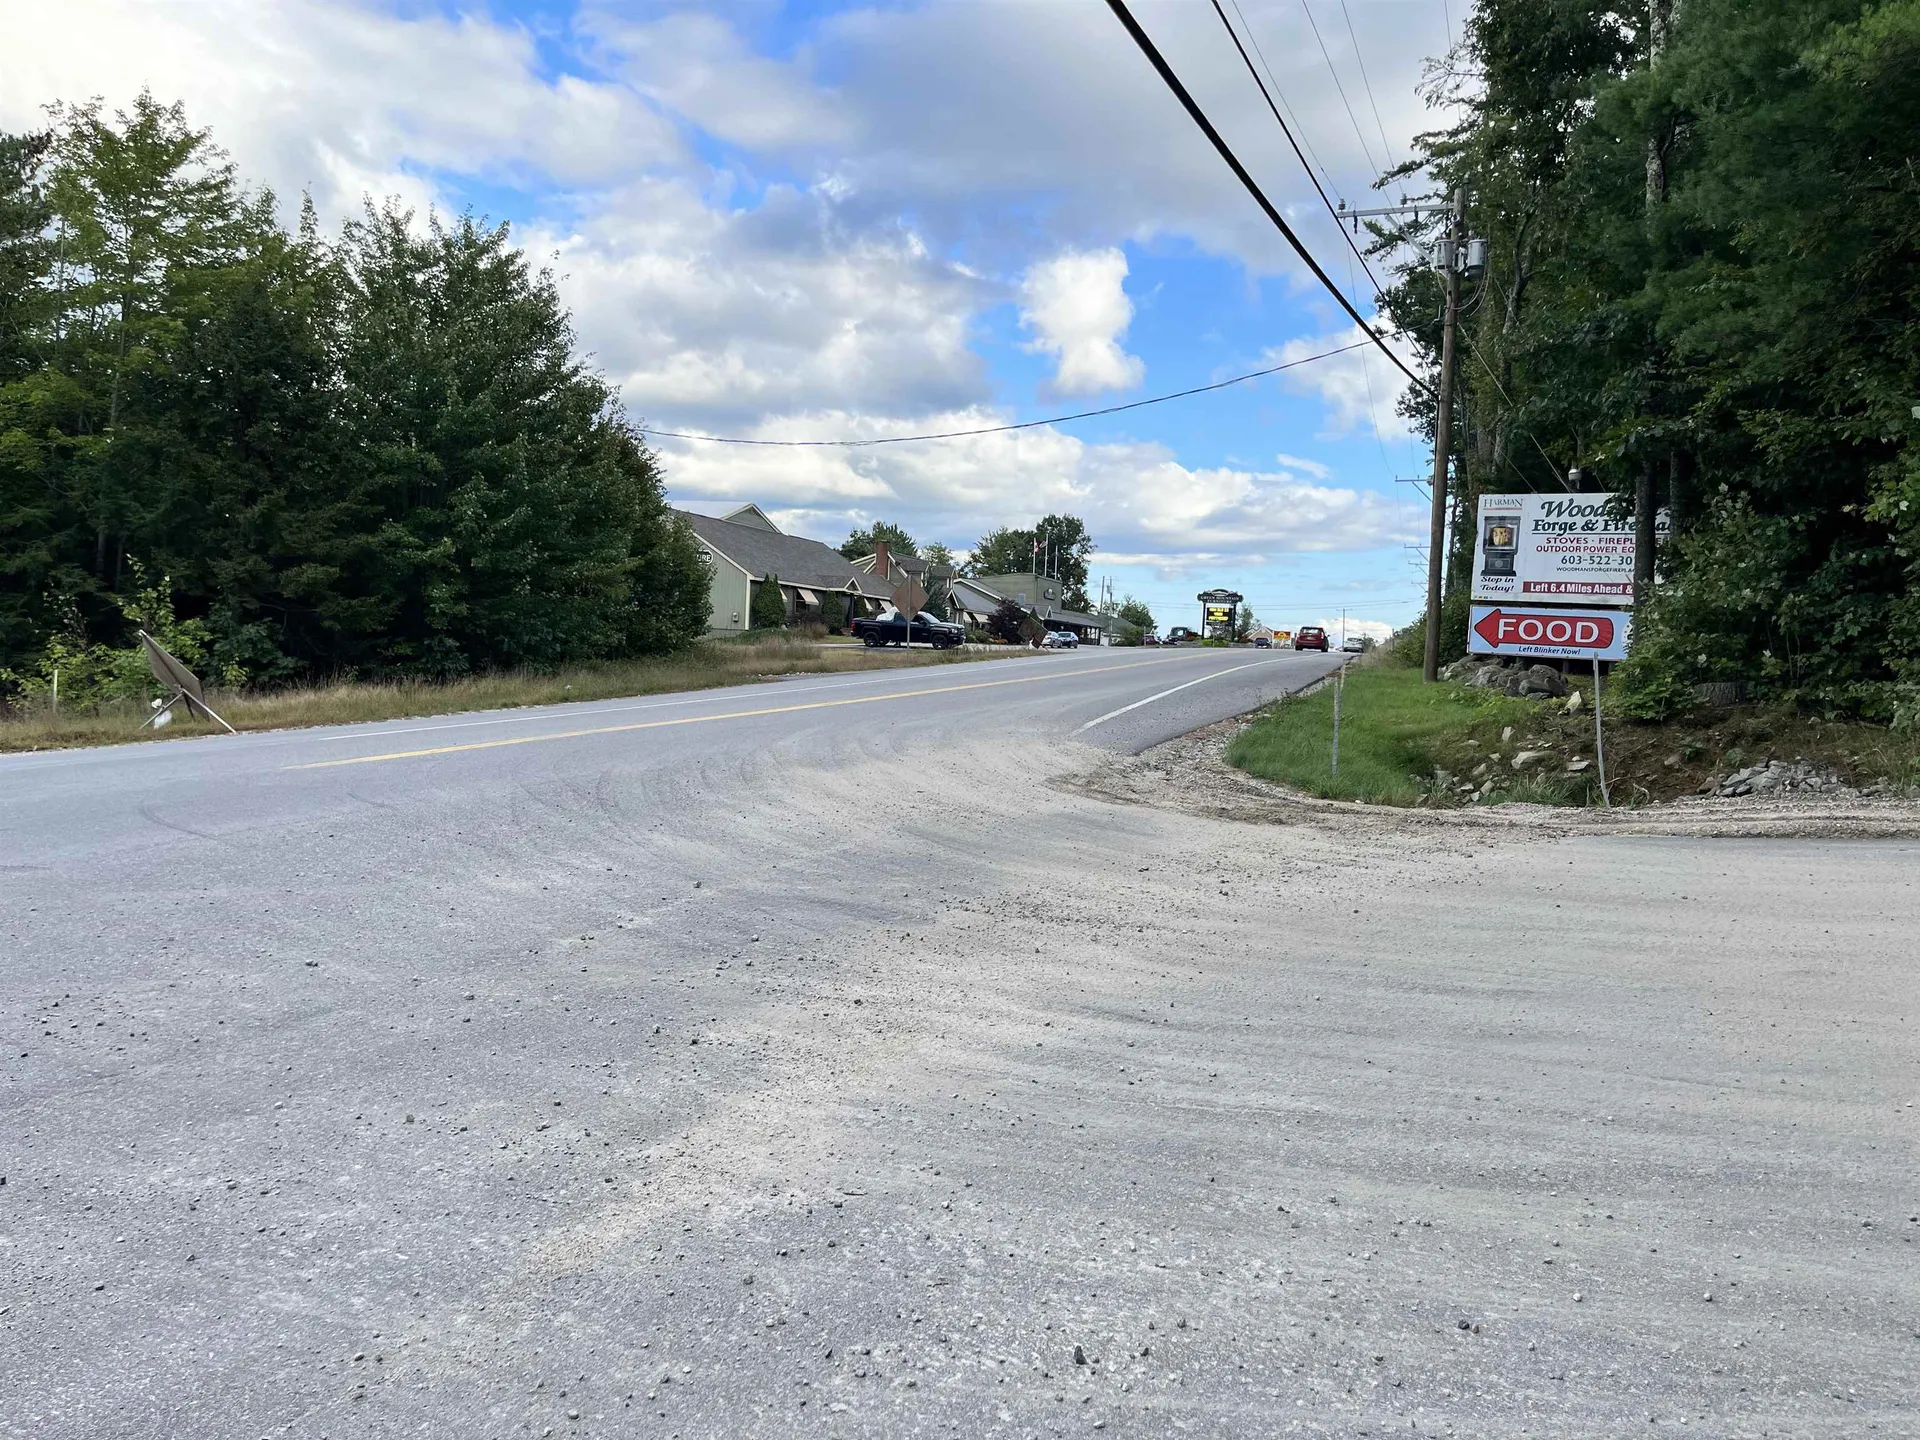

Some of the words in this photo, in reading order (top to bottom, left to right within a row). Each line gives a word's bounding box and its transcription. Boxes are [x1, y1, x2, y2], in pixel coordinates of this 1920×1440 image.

[1484, 498, 1523, 508] HARMAN
[1541, 498, 1608, 518] Wood
[1532, 519, 1577, 536] Forge
[1580, 519, 1599, 532] &
[1546, 537, 1588, 545] STOVES
[1536, 545, 1581, 553] OUTDOOR
[1583, 546, 1618, 554] POWER
[1621, 546, 1635, 554] EQ
[1561, 555, 1634, 566] 603-522-30
[1480, 576, 1502, 584] Stop
[1480, 584, 1515, 593] Today!
[1530, 582, 1549, 592] Left
[1550, 583, 1566, 593] 6.4
[1566, 583, 1592, 594] Miles
[1593, 584, 1623, 594] Ahead
[1625, 585, 1634, 594] &
[1497, 618, 1599, 643] FOOD
[1518, 645, 1533, 653] Left
[1533, 646, 1560, 655] Blinker
[1560, 647, 1581, 655] Now!
